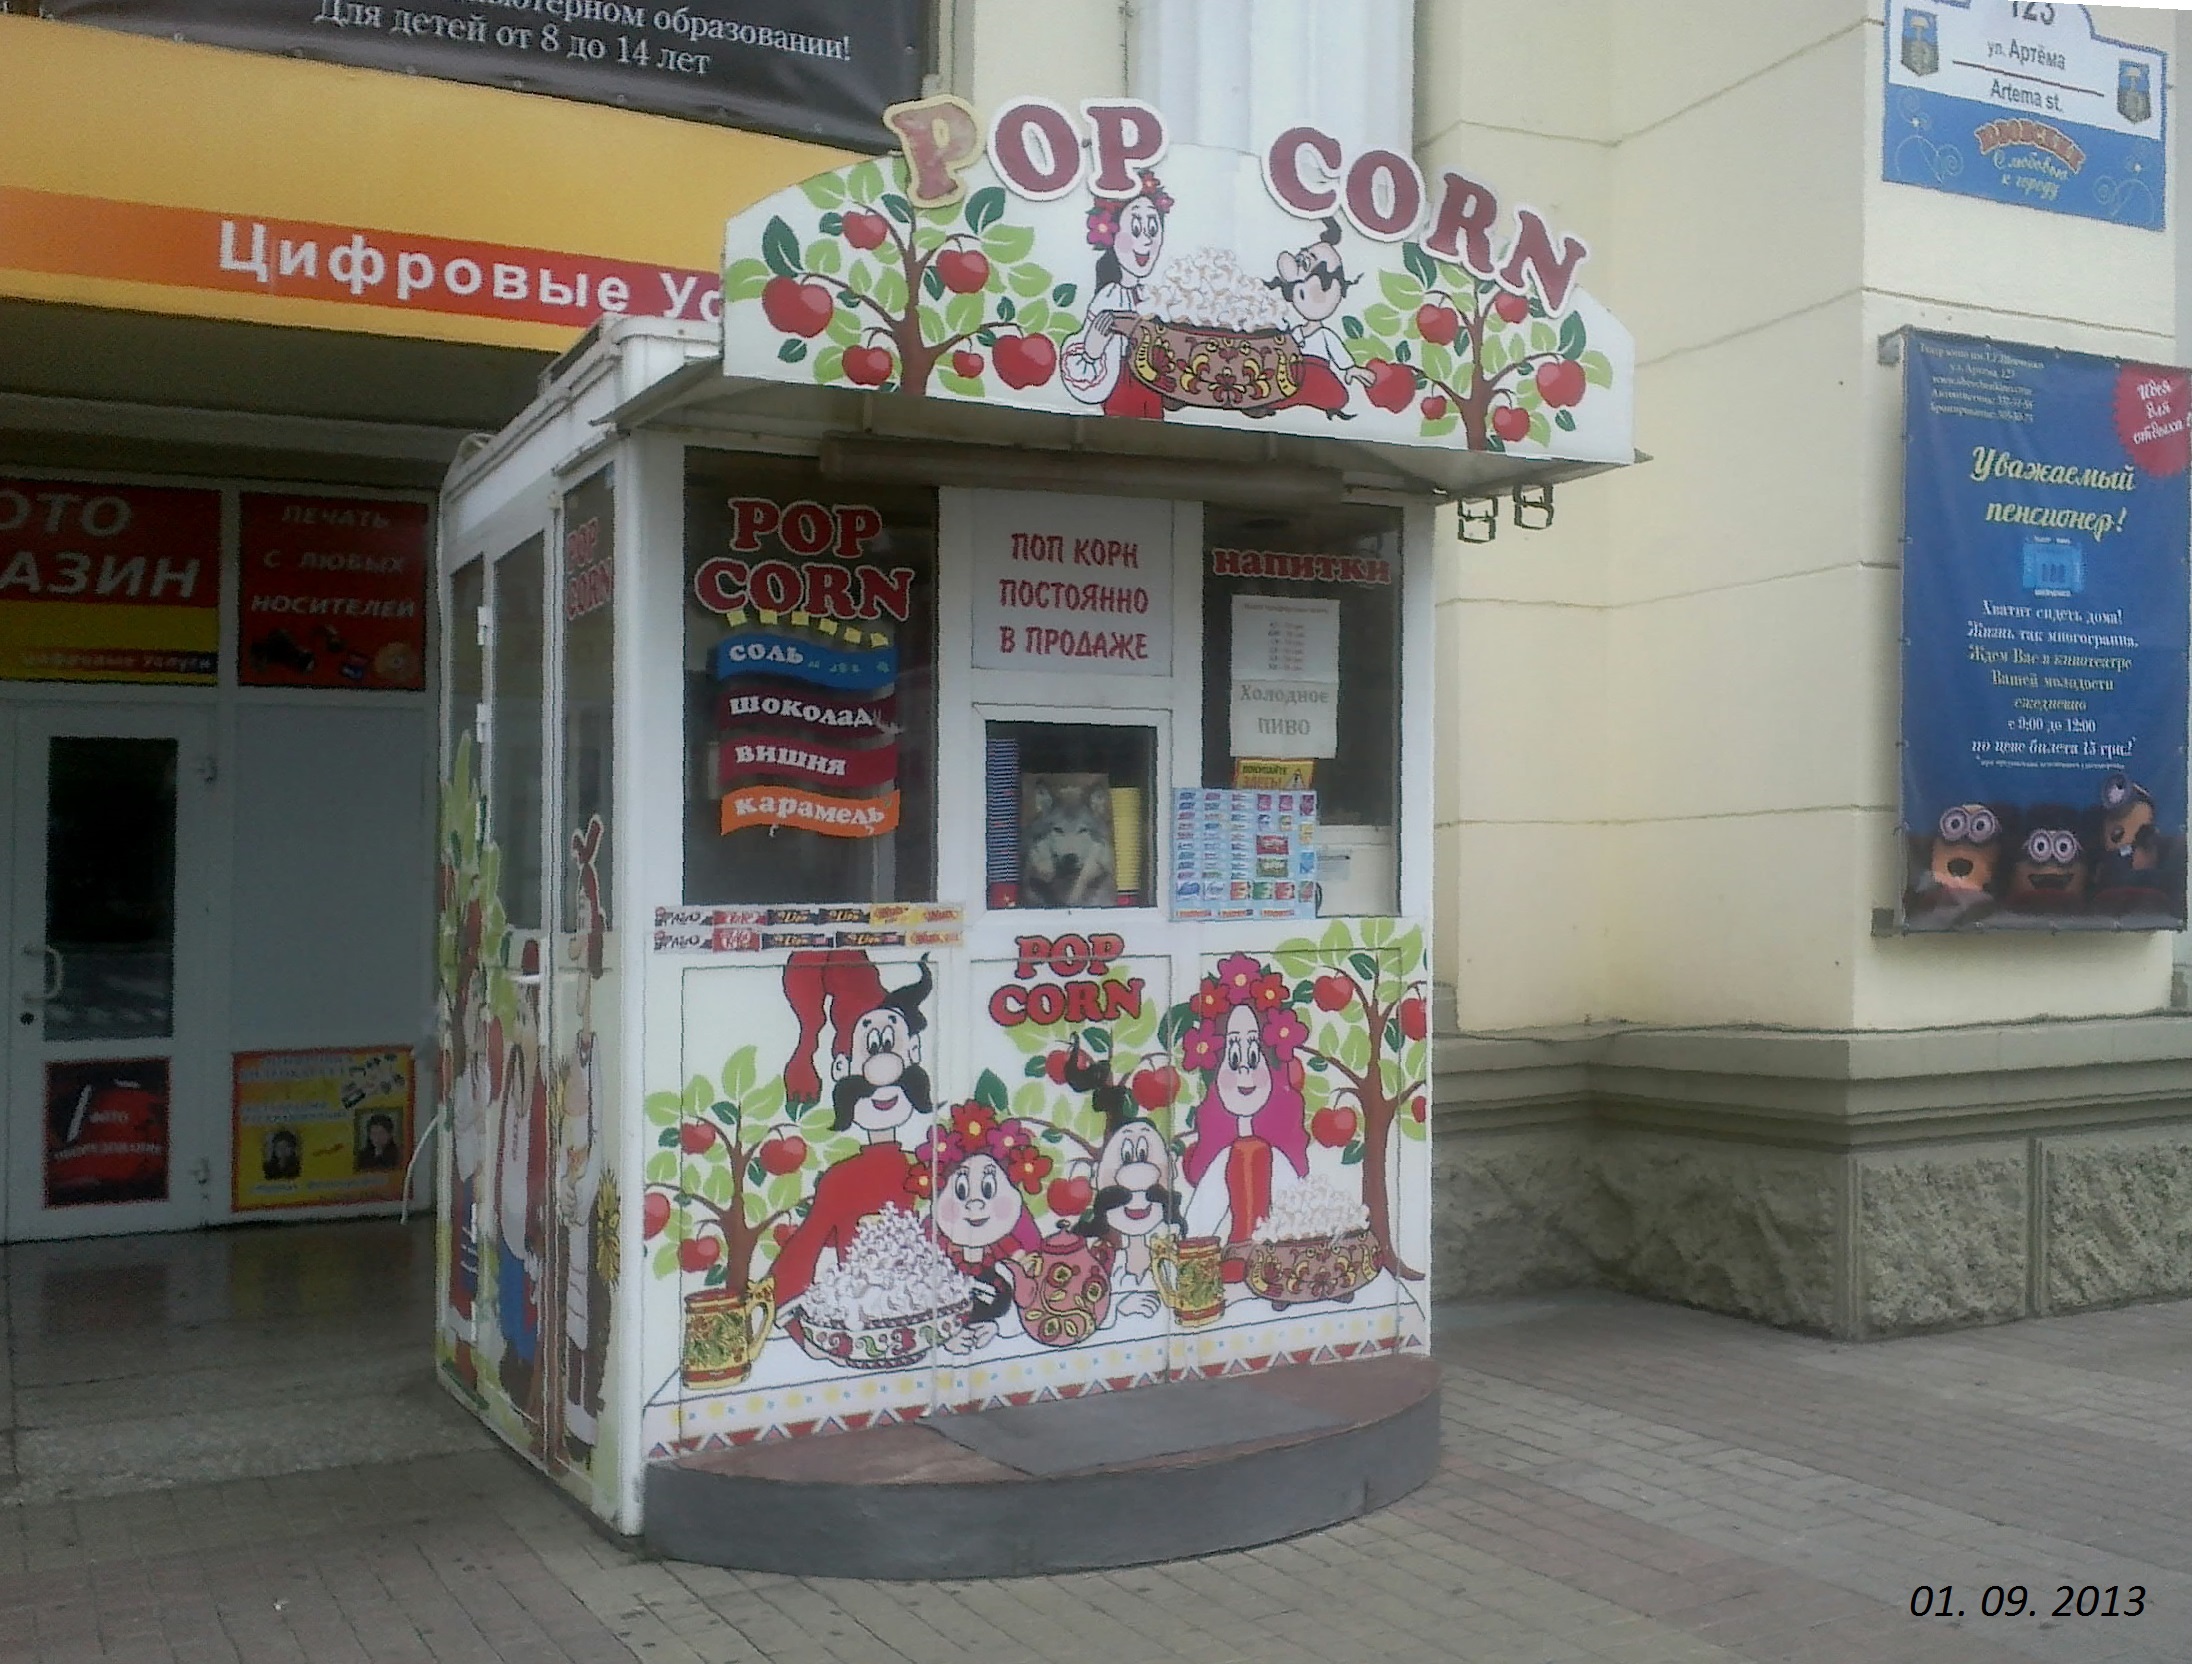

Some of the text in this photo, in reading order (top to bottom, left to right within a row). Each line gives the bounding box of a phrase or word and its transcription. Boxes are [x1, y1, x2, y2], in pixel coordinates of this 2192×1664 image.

[313, 0, 712, 75] Для детей от 8 до 14 лет
[653, 10, 851, 61] образовании!
[2009, 38, 2066, 70] Артёма
[1991, 79, 2064, 112] Artema st.
[886, 98, 1588, 317] POP CORN
[219, 220, 630, 312] Цифровые
[1970, 445, 2136, 491] Уважаемый
[281, 505, 391, 529] ПЕЧАТЬ
[728, 498, 882, 559] POP
[1986, 501, 2128, 542] пенсионер!
[263, 549, 282, 570] С
[1011, 532, 1138, 569] ПОП КОРН
[1212, 547, 1391, 584] напитки
[0, 550, 201, 599] АЗИН
[695, 557, 914, 620] CORN
[1000, 578, 1149, 615] ПОСТОЯННО
[1982, 600, 2123, 626] Хватит сидеть дома!
[1000, 626, 1148, 660] В ПРОДАЖЕ
[1967, 621, 2015, 640] Жизнь
[2019, 630, 2043, 642] так
[2013, 648, 2039, 665] Вас
[2054, 654, 2133, 672] кинотеатре
[1240, 684, 1330, 705] Холодное
[1991, 669, 2114, 691] Вашей молодости
[2047, 720, 2062, 733] до
[2067, 718, 2097, 733] 12:00
[1972, 740, 1991, 752] по
[1995, 741, 2026, 754] цене
[2029, 739, 2079, 755] билета
[2083, 741, 2096, 755] 15
[734, 795, 885, 826] карамель
[1014, 933, 1125, 979] POP
[988, 978, 1146, 1026] CORN
